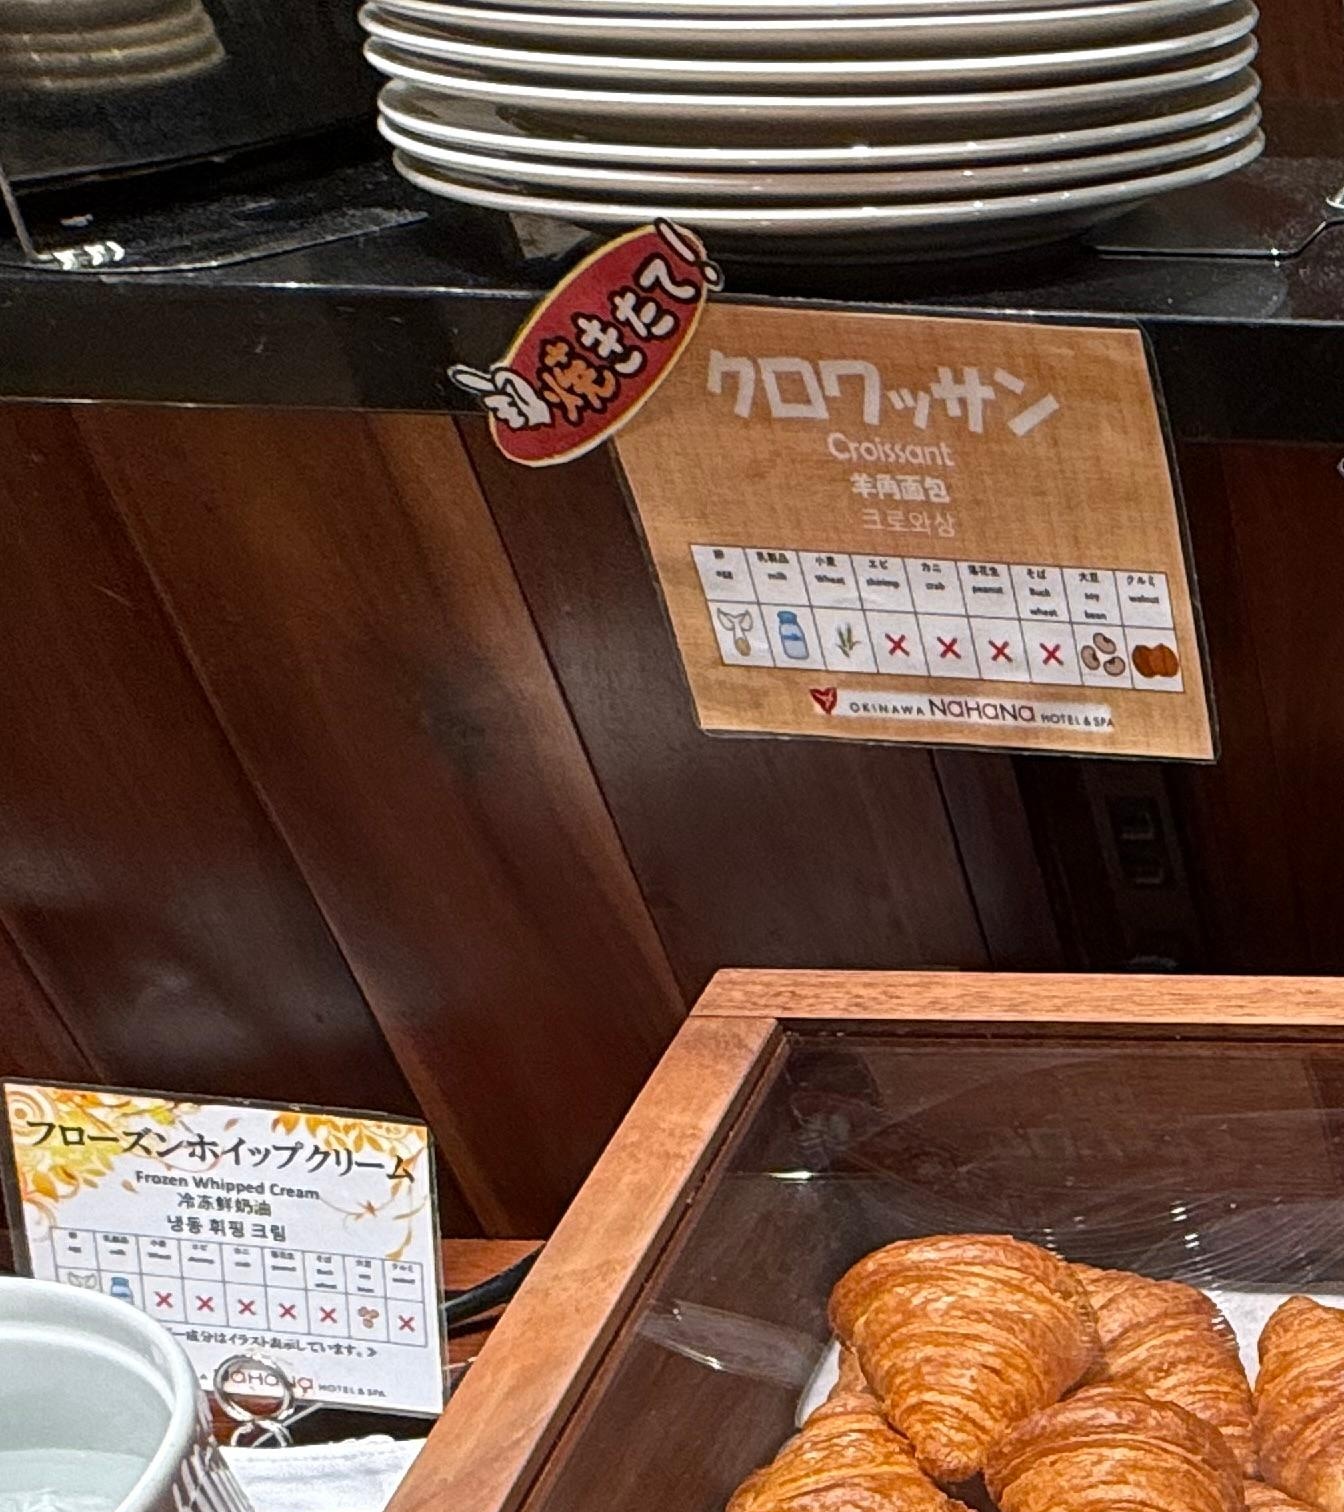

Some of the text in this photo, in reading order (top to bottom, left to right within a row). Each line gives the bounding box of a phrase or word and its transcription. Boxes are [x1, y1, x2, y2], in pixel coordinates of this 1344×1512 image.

[706, 349, 1060, 437] クロワッサン
[827, 431, 955, 466] Croissant
[850, 472, 949, 503] 羊角面包
[862, 508, 956, 538] 크로와상
[850, 702, 925, 716] OKINAWA
[1041, 713, 1080, 725] HOTEL
[26, 1120, 415, 1184] フローズンホイップクリーム
[135, 1170, 320, 1200] Frozen Whipped Cream
[251, 1223, 287, 1242] 크림
